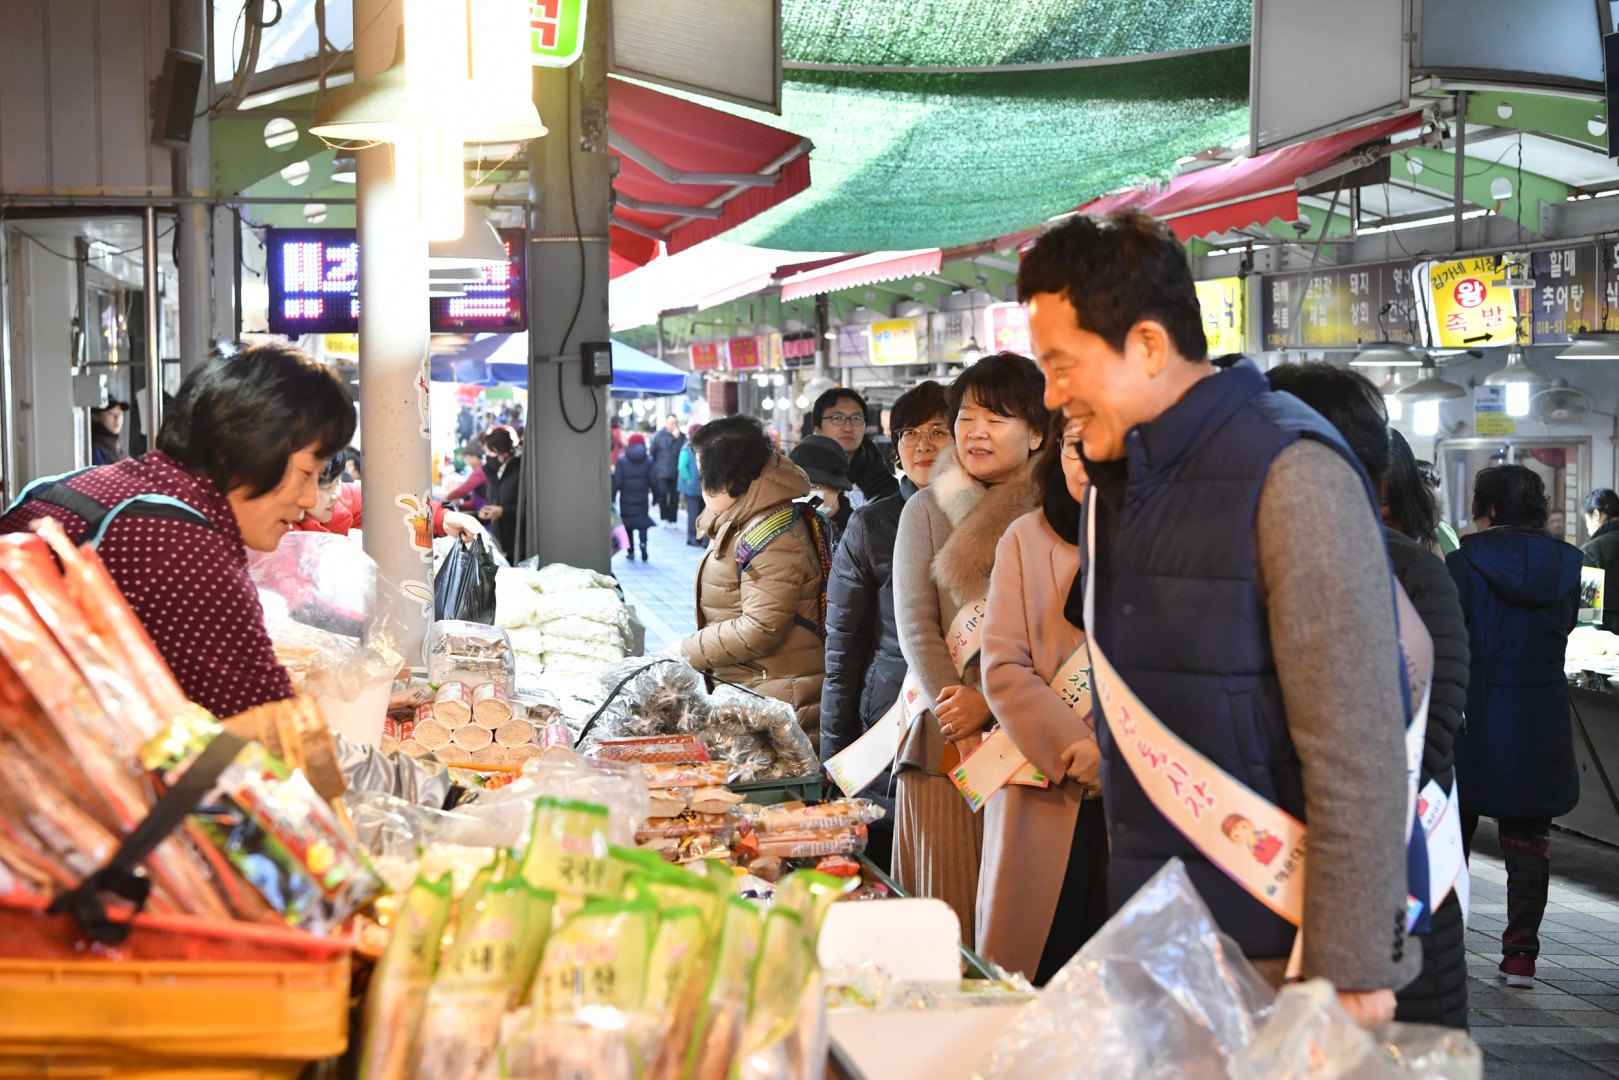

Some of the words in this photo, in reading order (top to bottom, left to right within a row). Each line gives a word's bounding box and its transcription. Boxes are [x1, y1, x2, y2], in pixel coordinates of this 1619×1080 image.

[1431, 261, 1468, 290] 김가네
[1549, 249, 1576, 279] 할매
[1457, 280, 1484, 308] 왕
[1542, 284, 1585, 314] 추어탕
